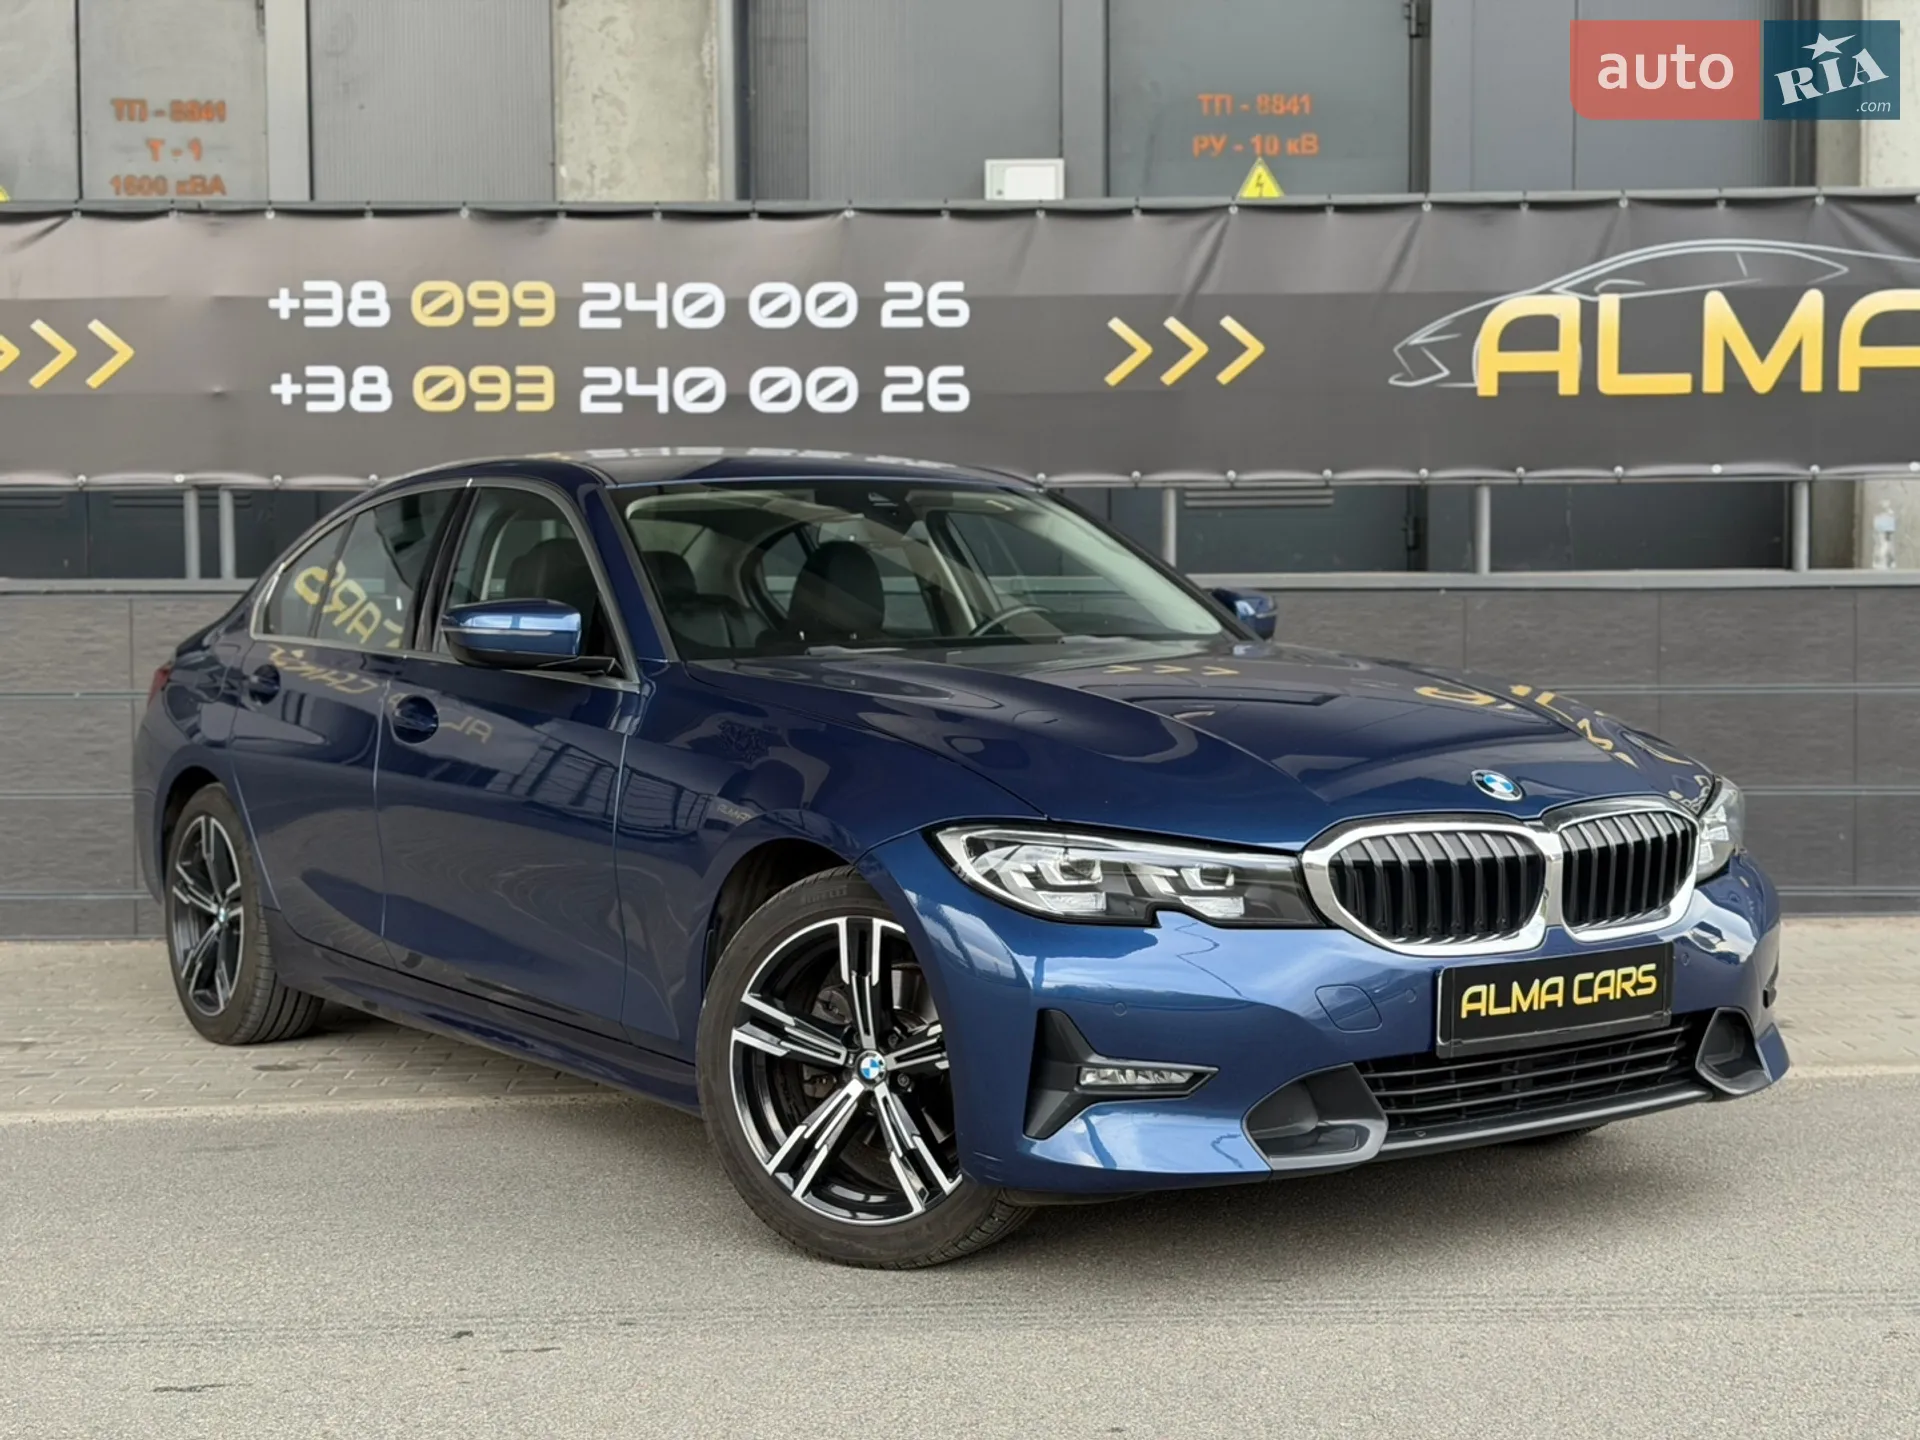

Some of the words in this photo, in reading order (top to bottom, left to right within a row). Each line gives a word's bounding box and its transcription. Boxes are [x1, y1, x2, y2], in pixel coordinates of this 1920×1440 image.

[1250, 134, 1282, 156] 10
[268, 280, 391, 328] +38
[410, 280, 556, 328] 099
[578, 281, 726, 329] 240
[748, 281, 858, 329] 00
[881, 281, 970, 328] 26
[1476, 289, 1920, 397] ALMA
[270, 365, 393, 413] +38
[412, 365, 555, 412] 093
[579, 366, 726, 414] 240
[749, 366, 859, 413] 00
[881, 365, 970, 413] 26
[1460, 976, 1564, 1019] ALMA
[1572, 963, 1658, 1006] CARS
